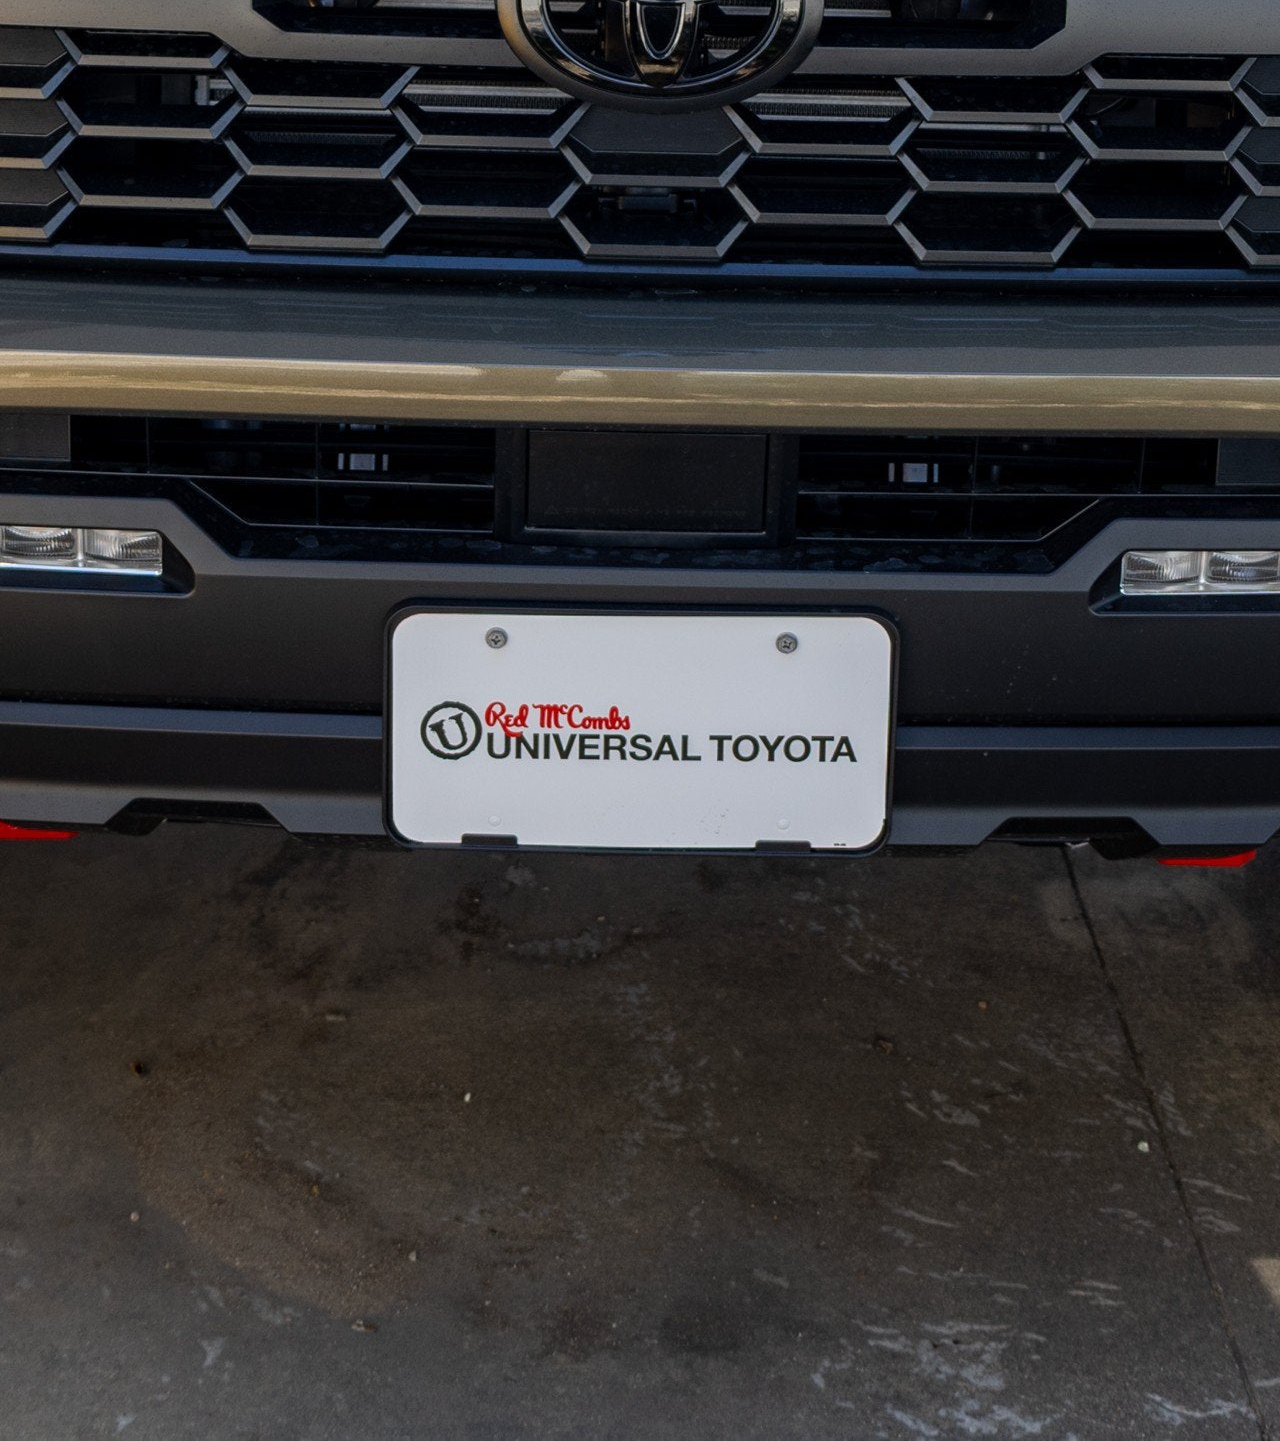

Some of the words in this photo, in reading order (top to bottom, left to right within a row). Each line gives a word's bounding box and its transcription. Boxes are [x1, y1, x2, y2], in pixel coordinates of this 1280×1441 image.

[484, 701, 529, 738] Red
[532, 703, 631, 730] McCombs
[486, 731, 702, 761] UNIVERSAL
[708, 733, 858, 763] TOYOTA
